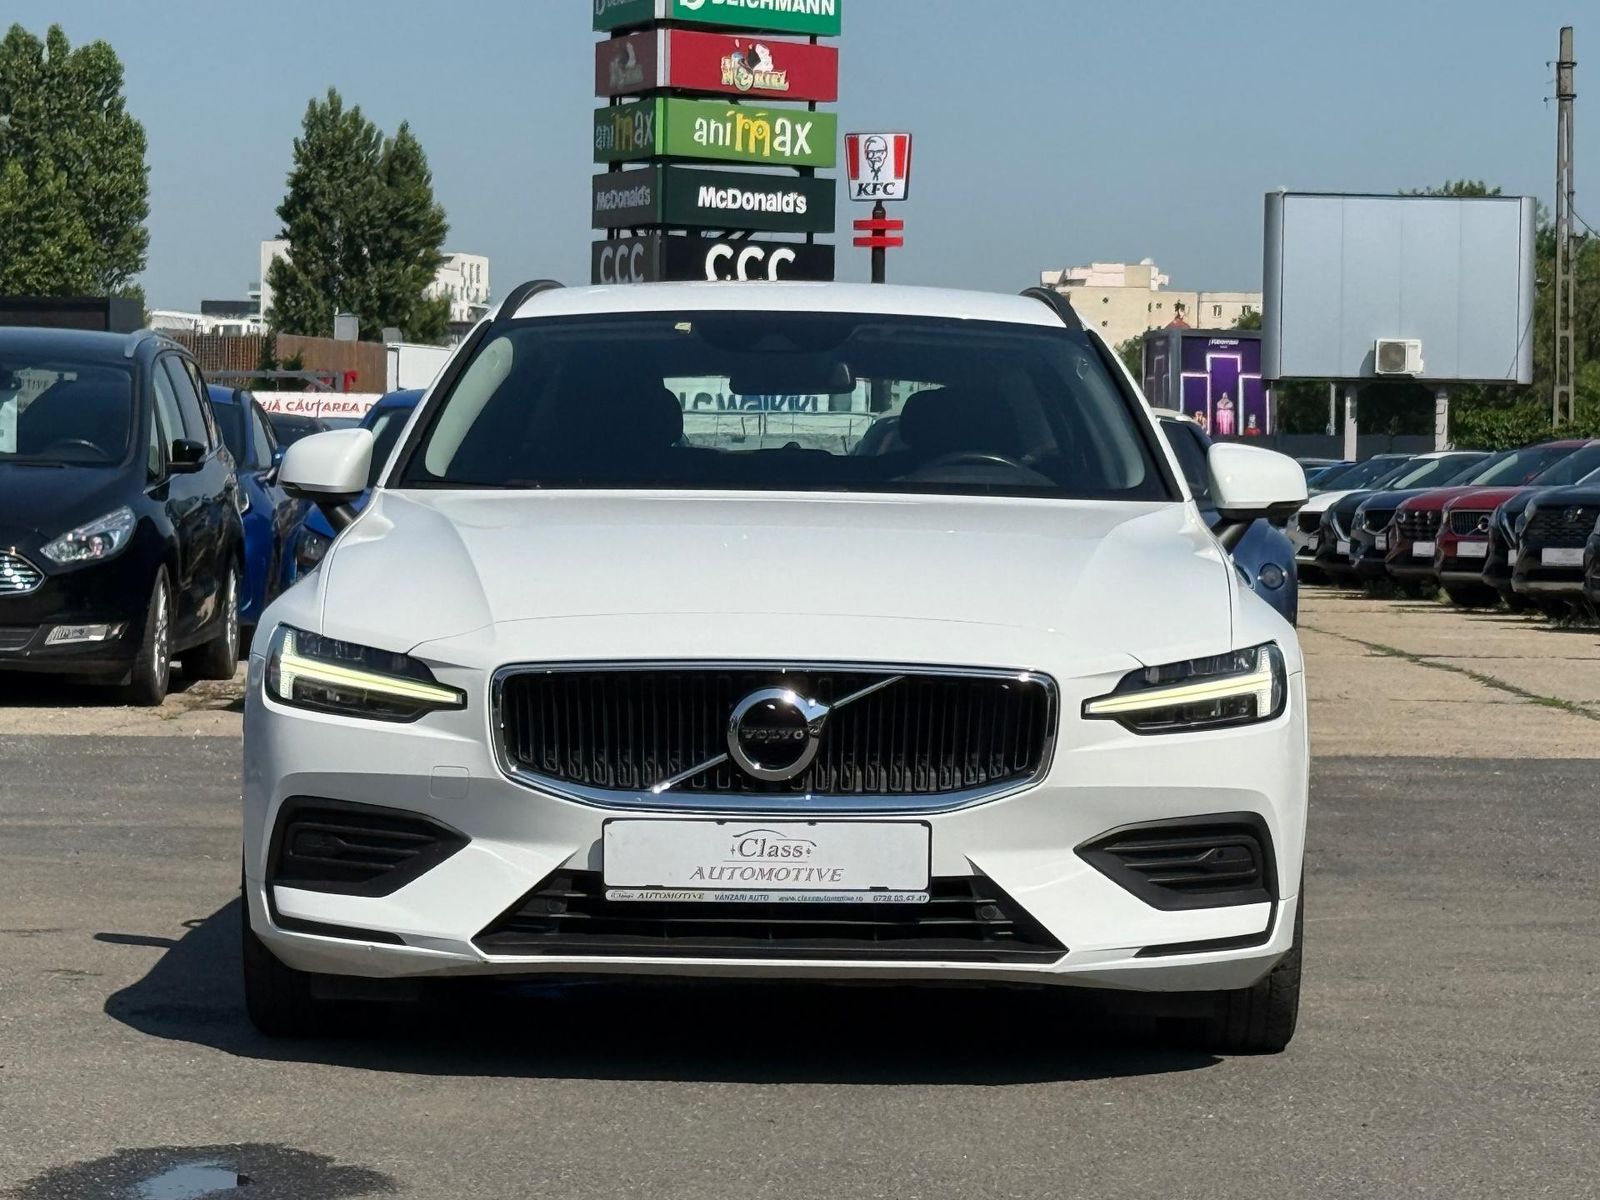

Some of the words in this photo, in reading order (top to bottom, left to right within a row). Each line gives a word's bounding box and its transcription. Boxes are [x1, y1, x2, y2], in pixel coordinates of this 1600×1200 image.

[711, 0, 835, 16] HMANN
[857, 182, 896, 197] KFC
[698, 185, 807, 214] McDonald's
[600, 242, 644, 285] CCC
[705, 243, 796, 281] CCC
[742, 728, 804, 740] VOLVO
[739, 838, 804, 858] Class
[689, 866, 845, 882] AUTOMOTIVE
